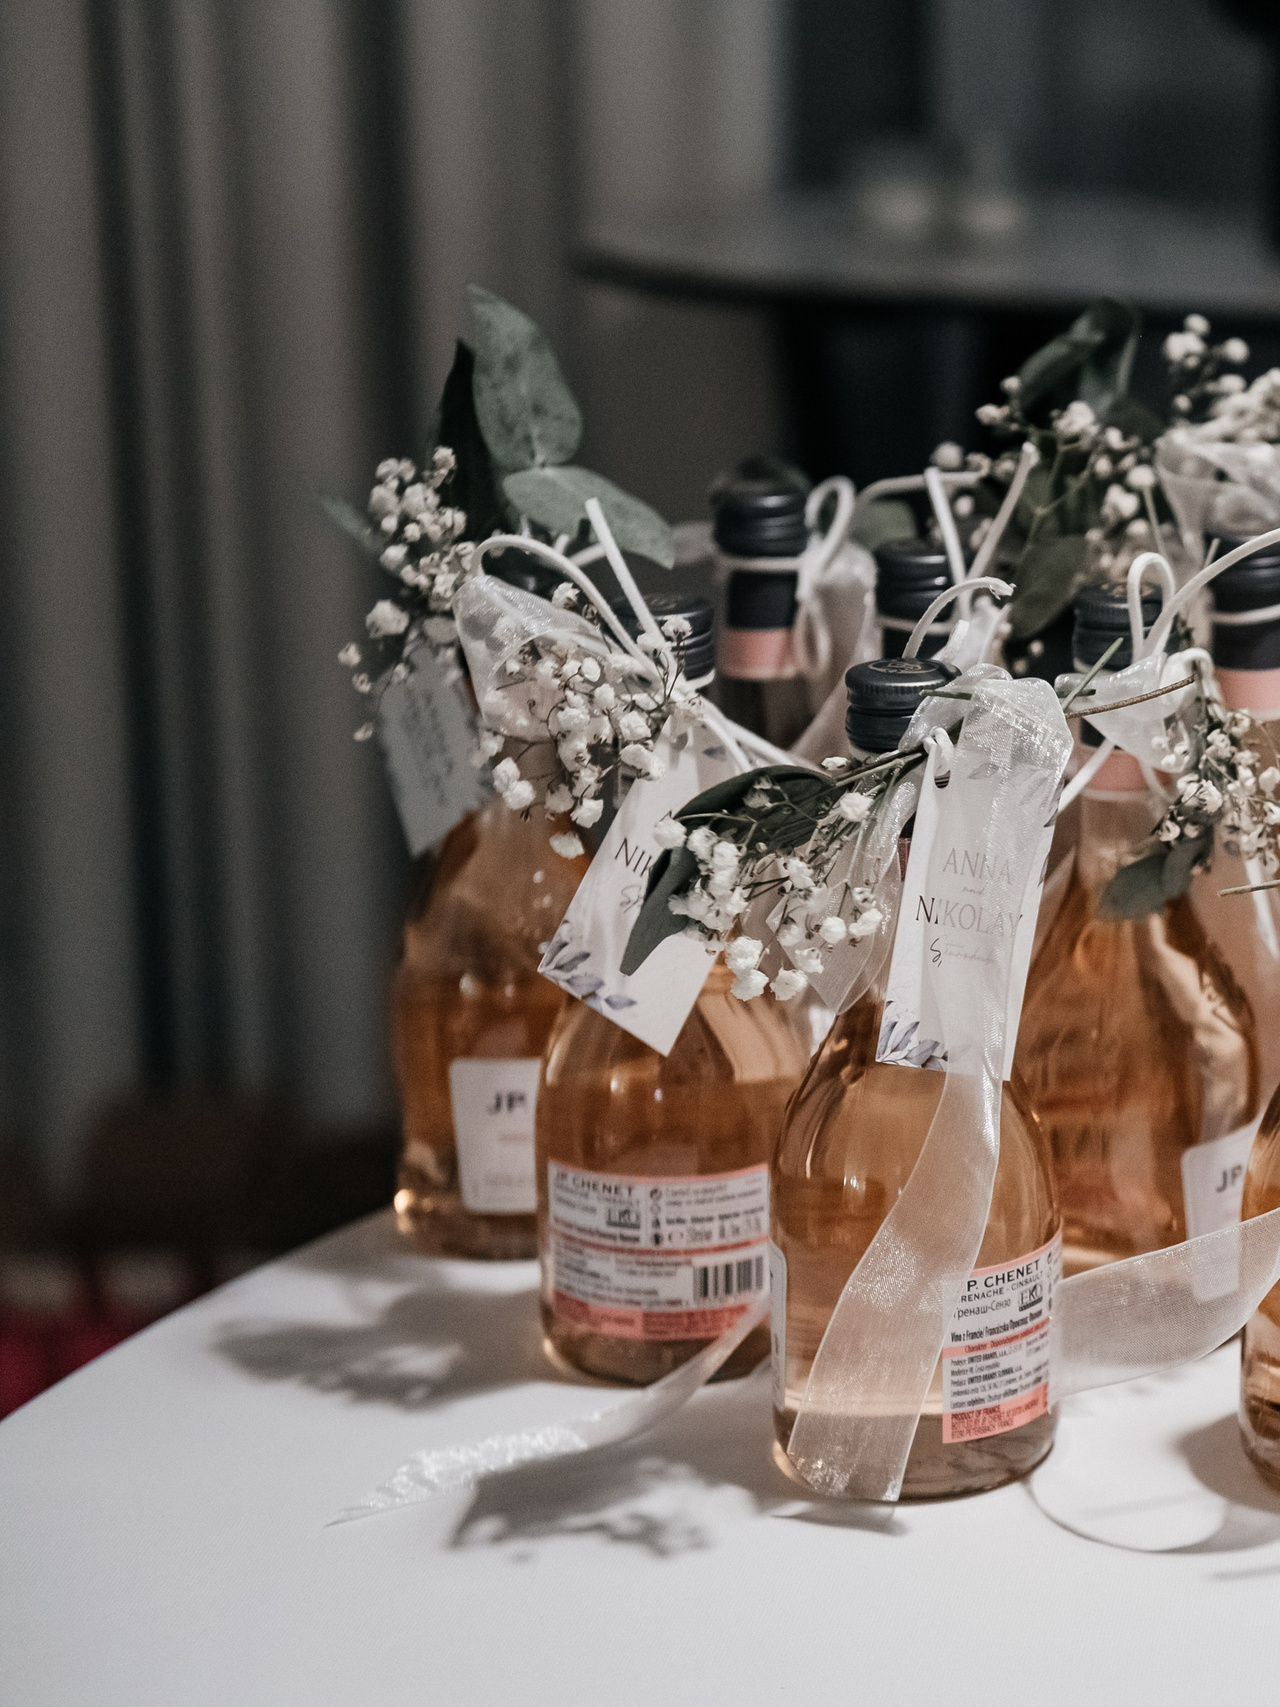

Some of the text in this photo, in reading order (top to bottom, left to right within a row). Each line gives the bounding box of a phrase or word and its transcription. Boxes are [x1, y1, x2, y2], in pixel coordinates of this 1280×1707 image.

[942, 848, 1012, 886] ANNA
[915, 895, 1024, 939] NIKOLAY
[984, 1258, 1041, 1289] CHENET
[960, 1286, 1005, 1303] RENACHE
